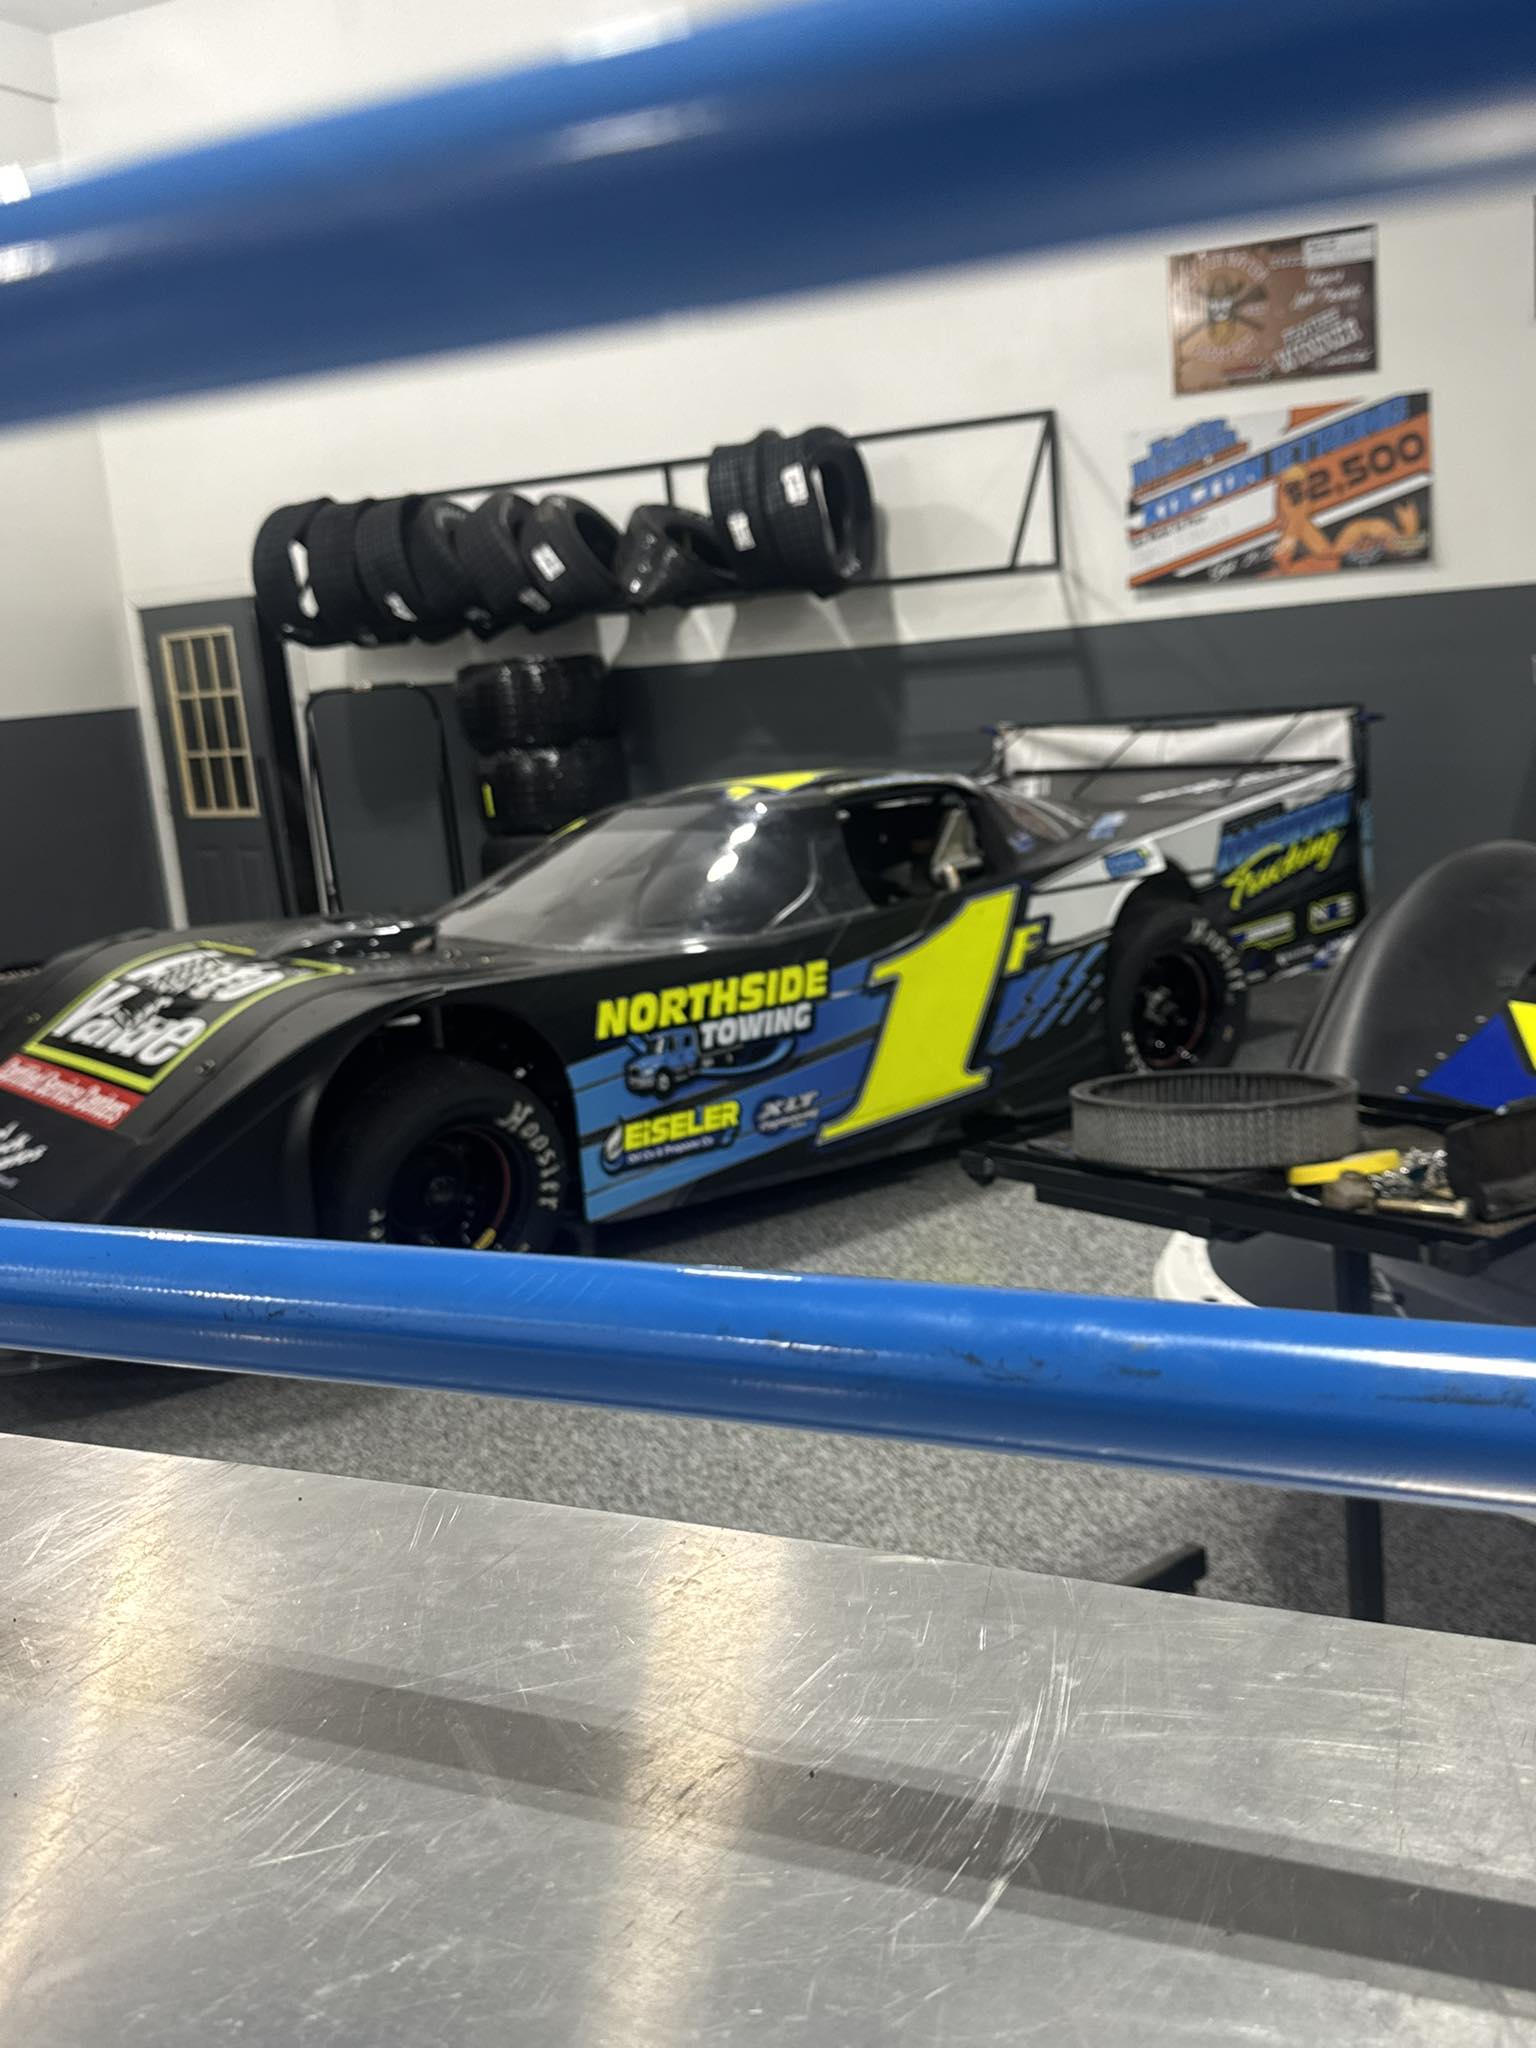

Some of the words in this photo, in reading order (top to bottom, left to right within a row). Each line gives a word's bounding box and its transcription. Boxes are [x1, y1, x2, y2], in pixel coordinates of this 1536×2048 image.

[595, 959, 829, 1040] NORTHSIDE
[701, 1001, 812, 1049] TOWING
[819, 886, 1019, 1143] 1
